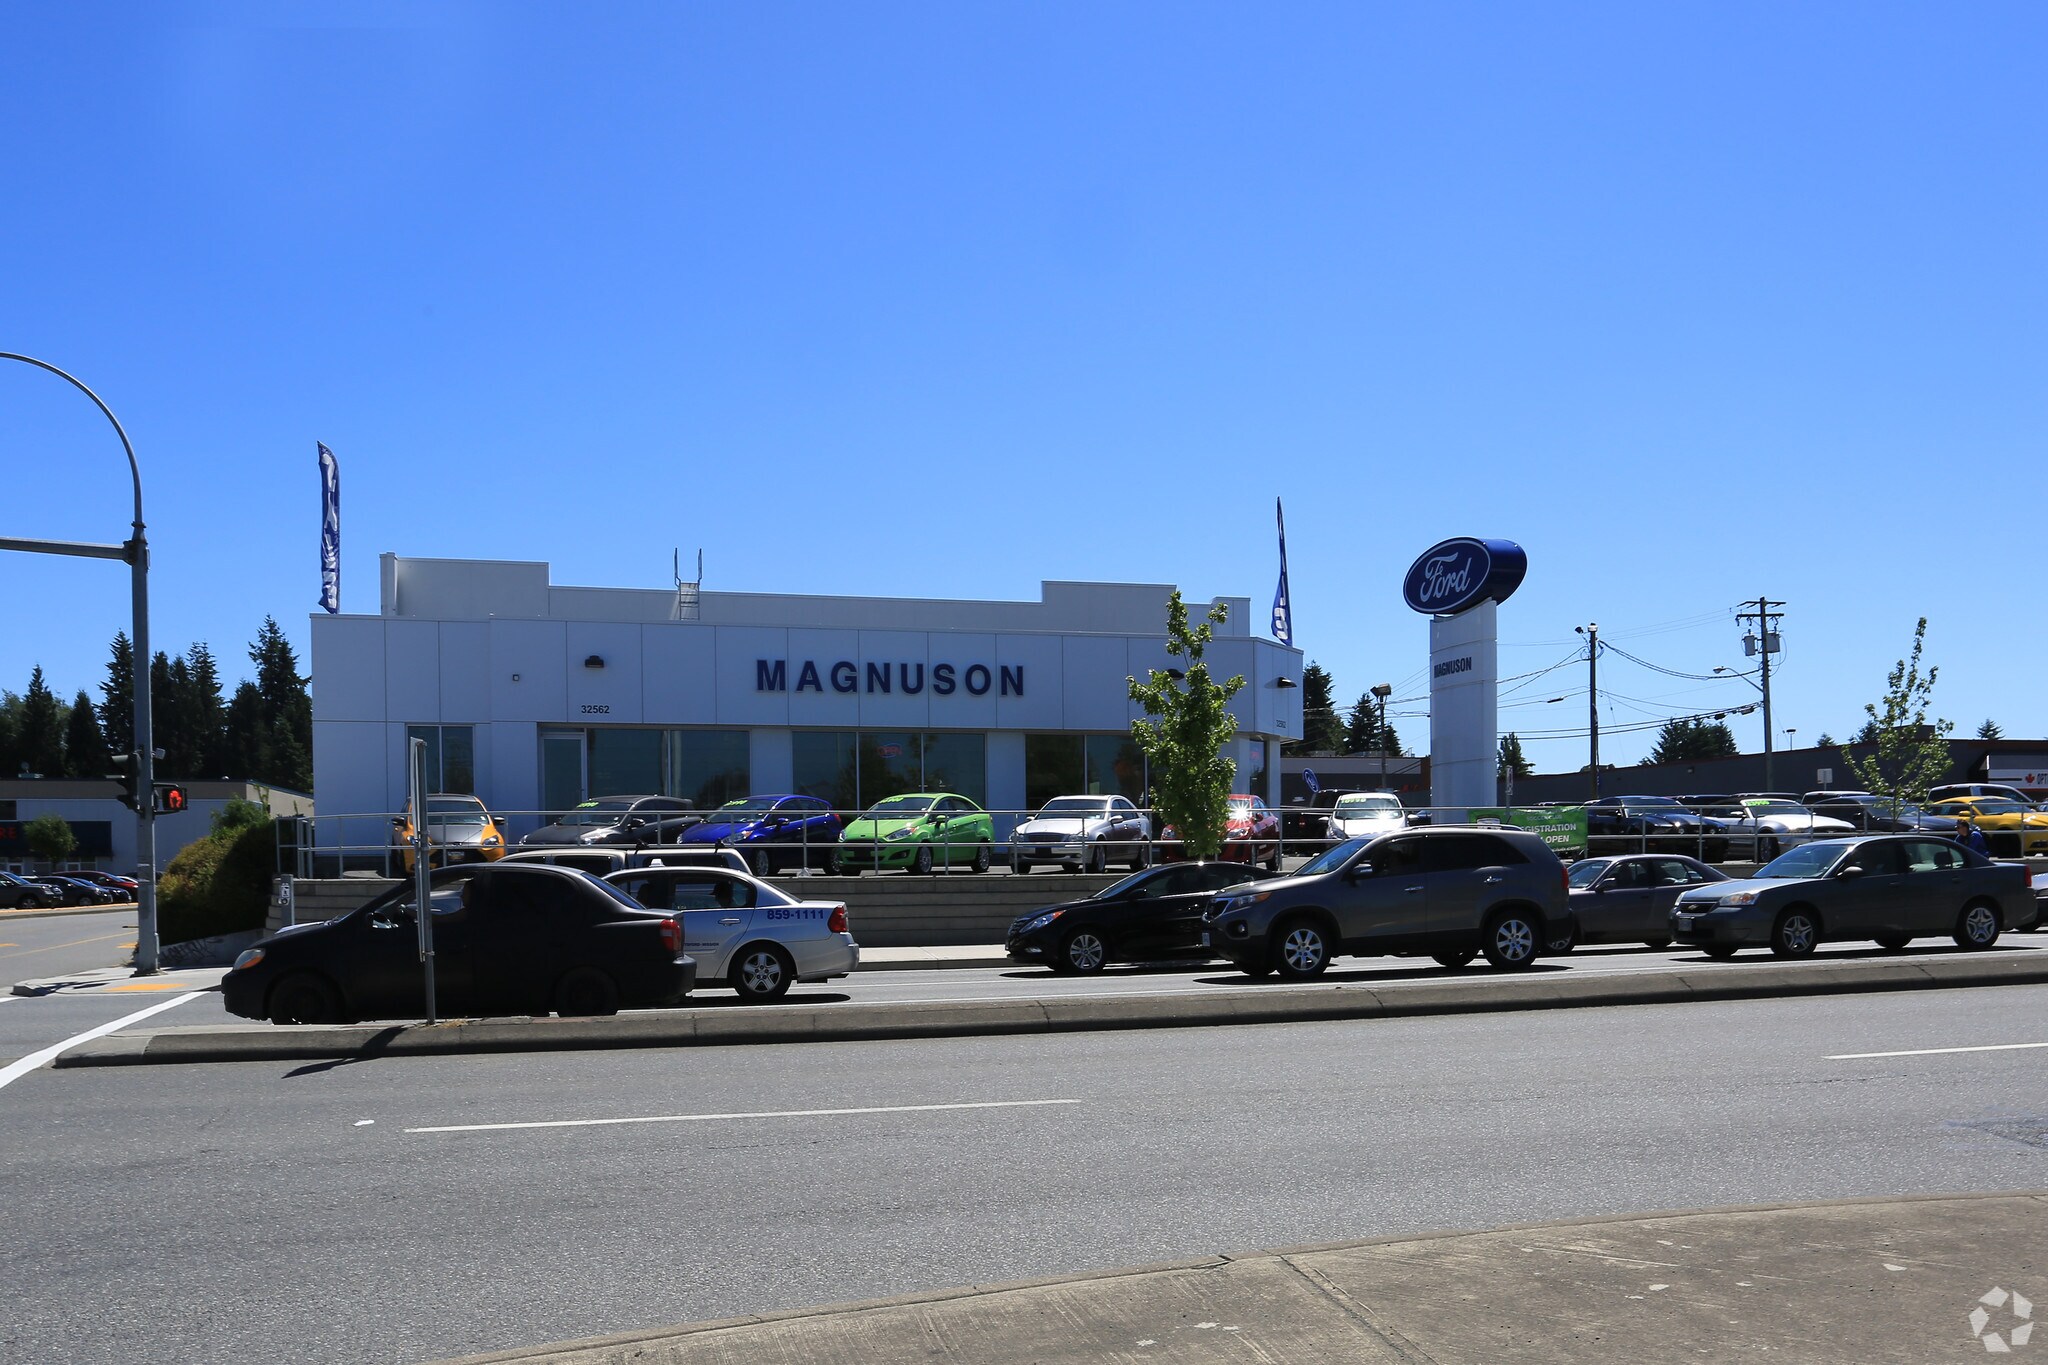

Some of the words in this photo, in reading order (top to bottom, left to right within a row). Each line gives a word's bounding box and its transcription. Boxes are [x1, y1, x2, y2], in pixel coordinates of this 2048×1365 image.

[1420, 551, 1473, 603] Ford
[756, 659, 1025, 697] MAGNUSON
[581, 704, 610, 714] 32562
[1545, 835, 1570, 844] OPEN
[767, 909, 824, 920] 859-1111
